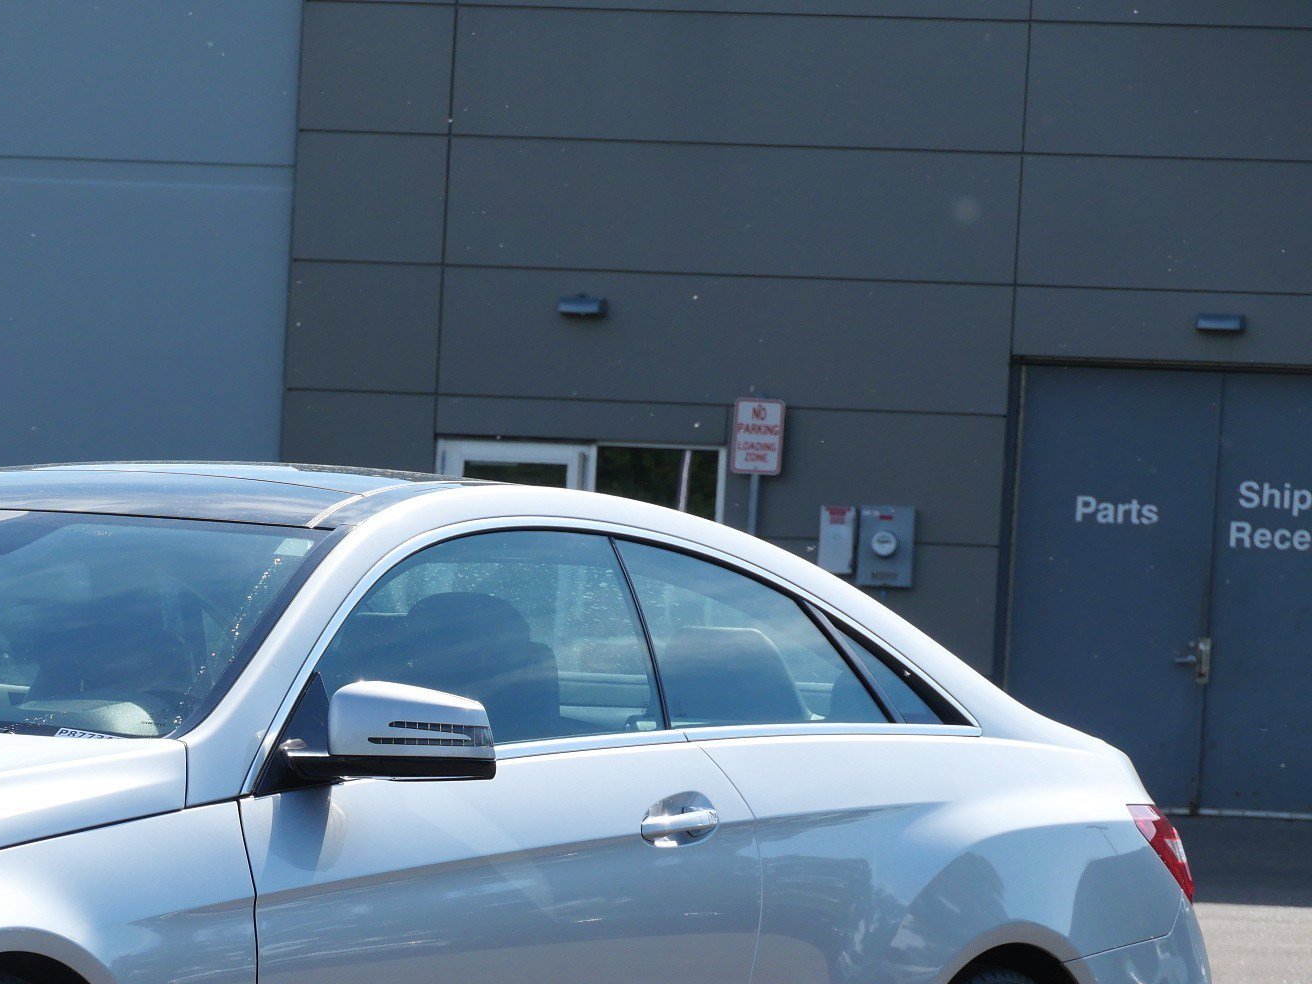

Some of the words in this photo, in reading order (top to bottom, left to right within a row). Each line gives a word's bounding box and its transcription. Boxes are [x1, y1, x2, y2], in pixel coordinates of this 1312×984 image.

[736, 423, 780, 436] PARKING
[1075, 495, 1159, 525] Parts
[1238, 480, 1312, 517] Ship
[1229, 520, 1312, 551] Rece
